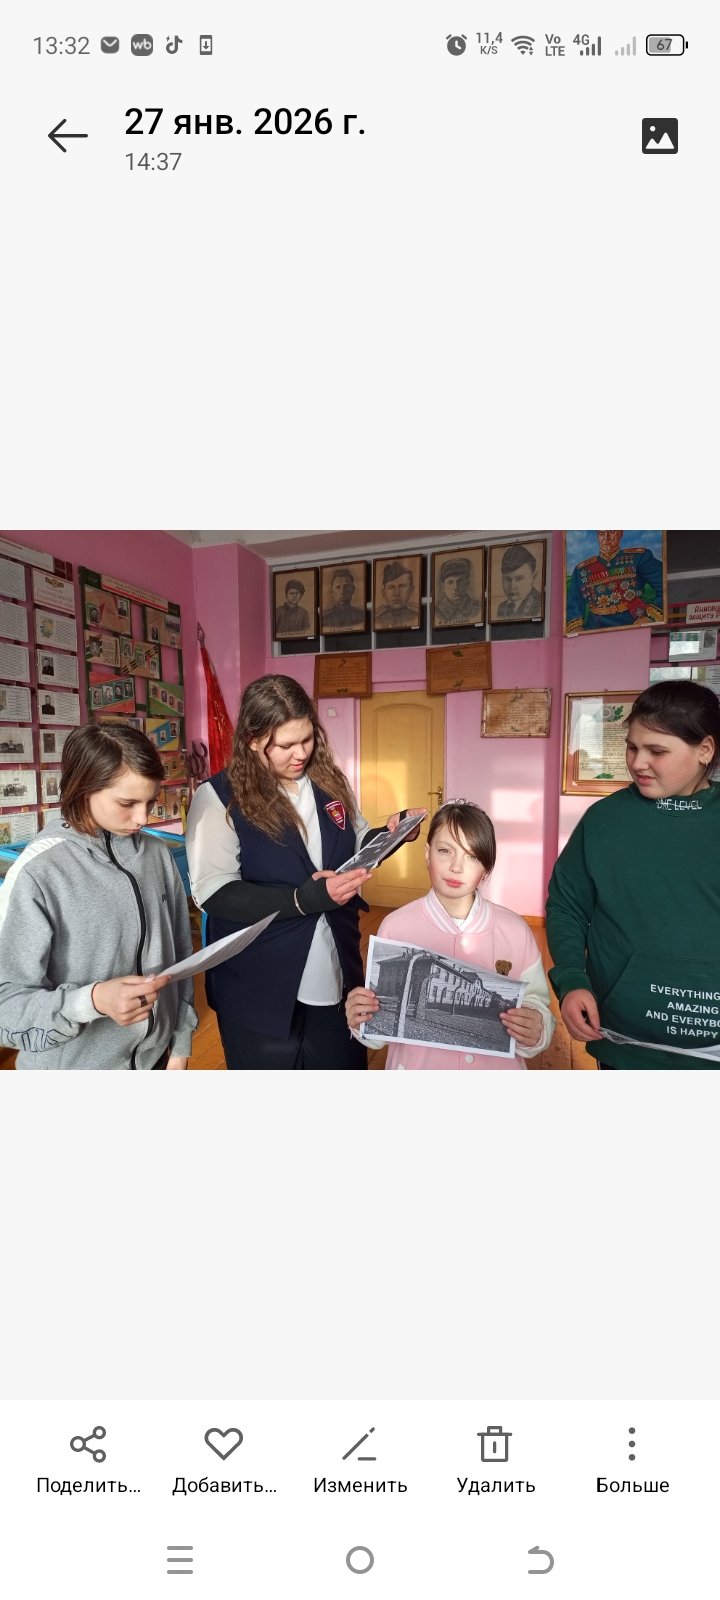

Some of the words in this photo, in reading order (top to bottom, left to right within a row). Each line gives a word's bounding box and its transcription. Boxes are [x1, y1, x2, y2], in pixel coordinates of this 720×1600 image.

[674, 800, 704, 811] LEVEL
[651, 984, 720, 1001] EVERYTHING
[667, 1002, 719, 1014] AMAZING
[646, 1010, 669, 1021] AND
[666, 1025, 677, 1035] IS
[680, 1027, 719, 1039] HAPPY
